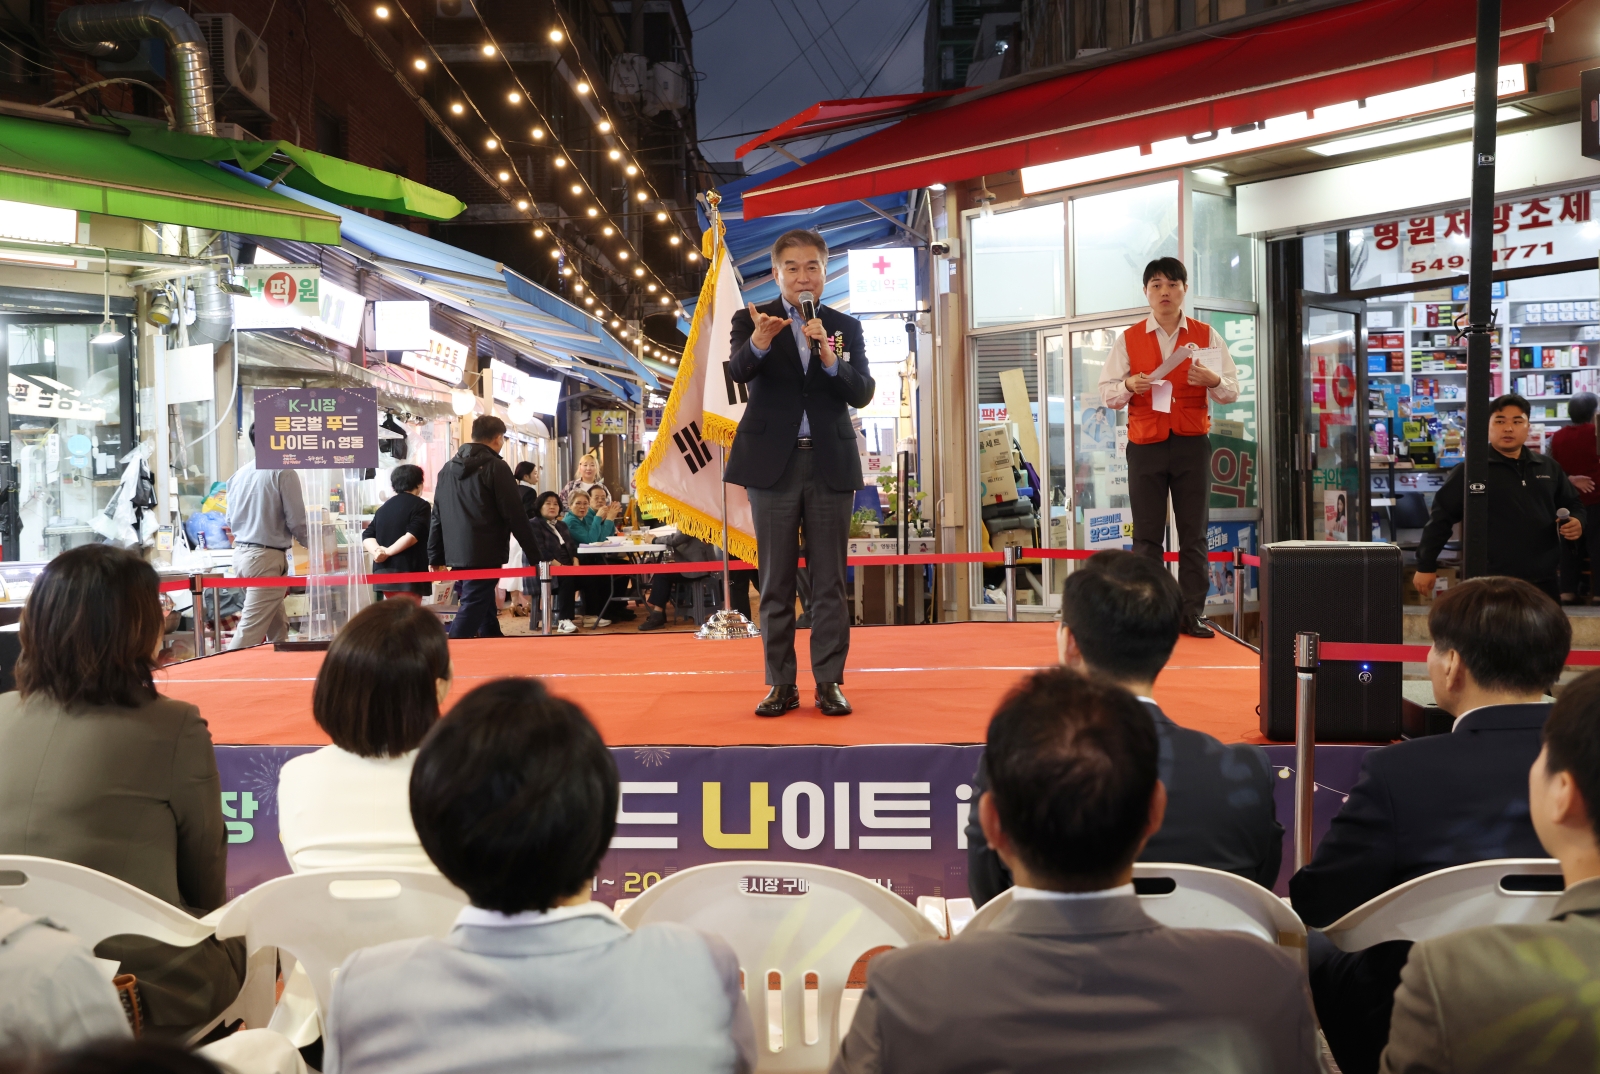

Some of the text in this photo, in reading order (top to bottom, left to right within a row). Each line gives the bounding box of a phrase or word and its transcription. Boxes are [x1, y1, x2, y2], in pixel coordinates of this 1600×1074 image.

[288, 398, 337, 412] K-시장
[274, 415, 359, 432] 글로벌 푸드
[270, 434, 364, 450] 나이트 in 영동
[1211, 447, 1254, 508] 약
[702, 781, 932, 850] 나이트
